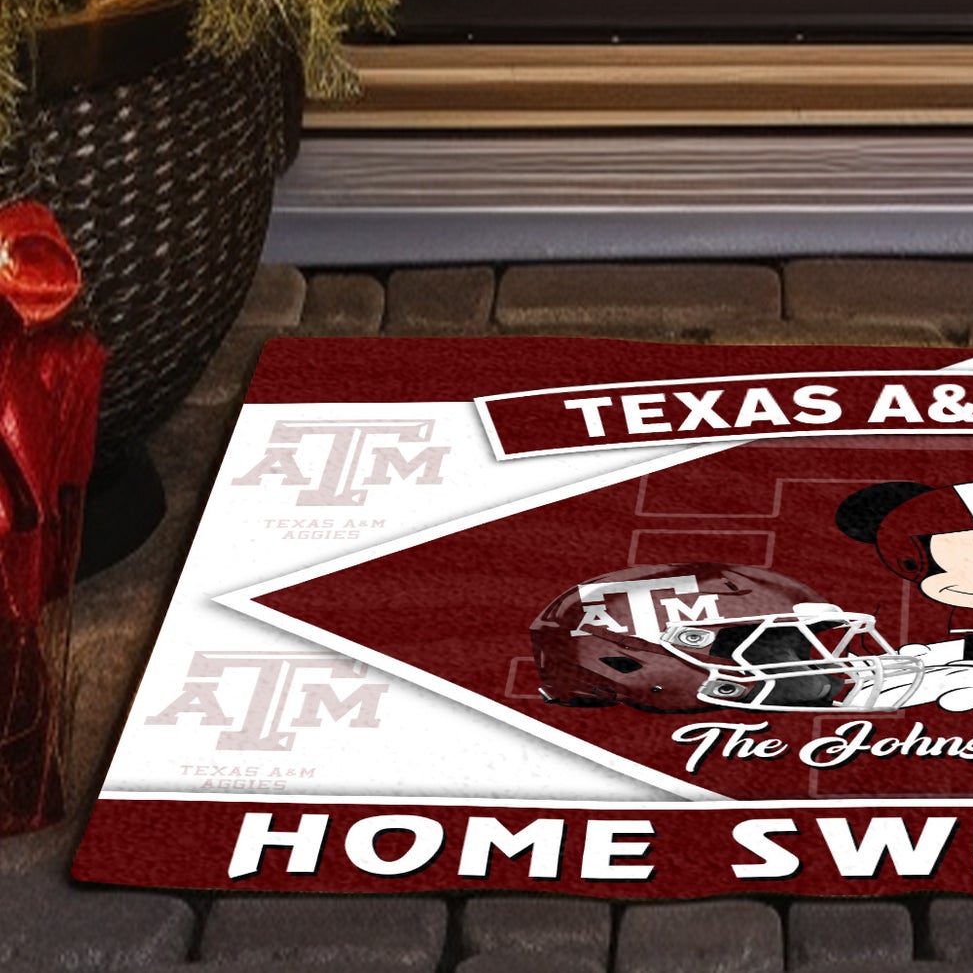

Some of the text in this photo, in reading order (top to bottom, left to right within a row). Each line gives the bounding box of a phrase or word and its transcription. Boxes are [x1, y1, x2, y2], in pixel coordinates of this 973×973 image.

[564, 384, 842, 438] TEXAS
[263, 518, 387, 529] TEXAS A&M
[281, 530, 361, 540] AGGIES
[671, 719, 788, 774] The
[180, 765, 317, 778] TEXAS A&M
[200, 779, 288, 791] AGGIES
[227, 811, 657, 880] HOME
